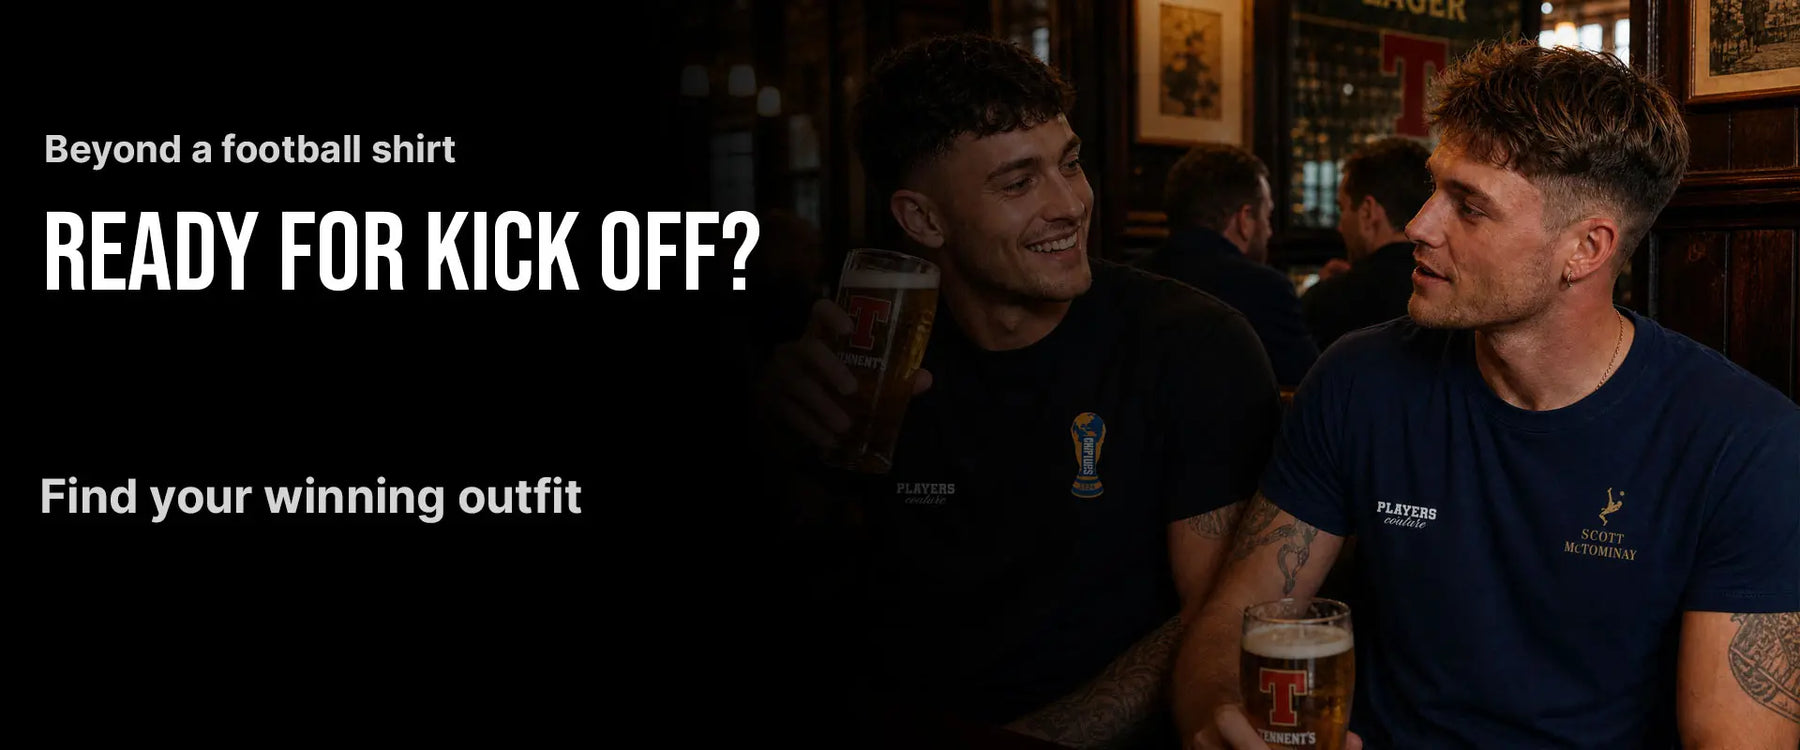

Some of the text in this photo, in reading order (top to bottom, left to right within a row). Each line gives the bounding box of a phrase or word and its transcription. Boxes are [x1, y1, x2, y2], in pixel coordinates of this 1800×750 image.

[1380, 30, 1449, 138] T
[895, 482, 956, 495] PLAYERS
[1376, 500, 1438, 521] PLAYERS
[1383, 516, 1427, 530] couture
[1580, 528, 1625, 544] SCOTT
[1259, 666, 1309, 727] T
